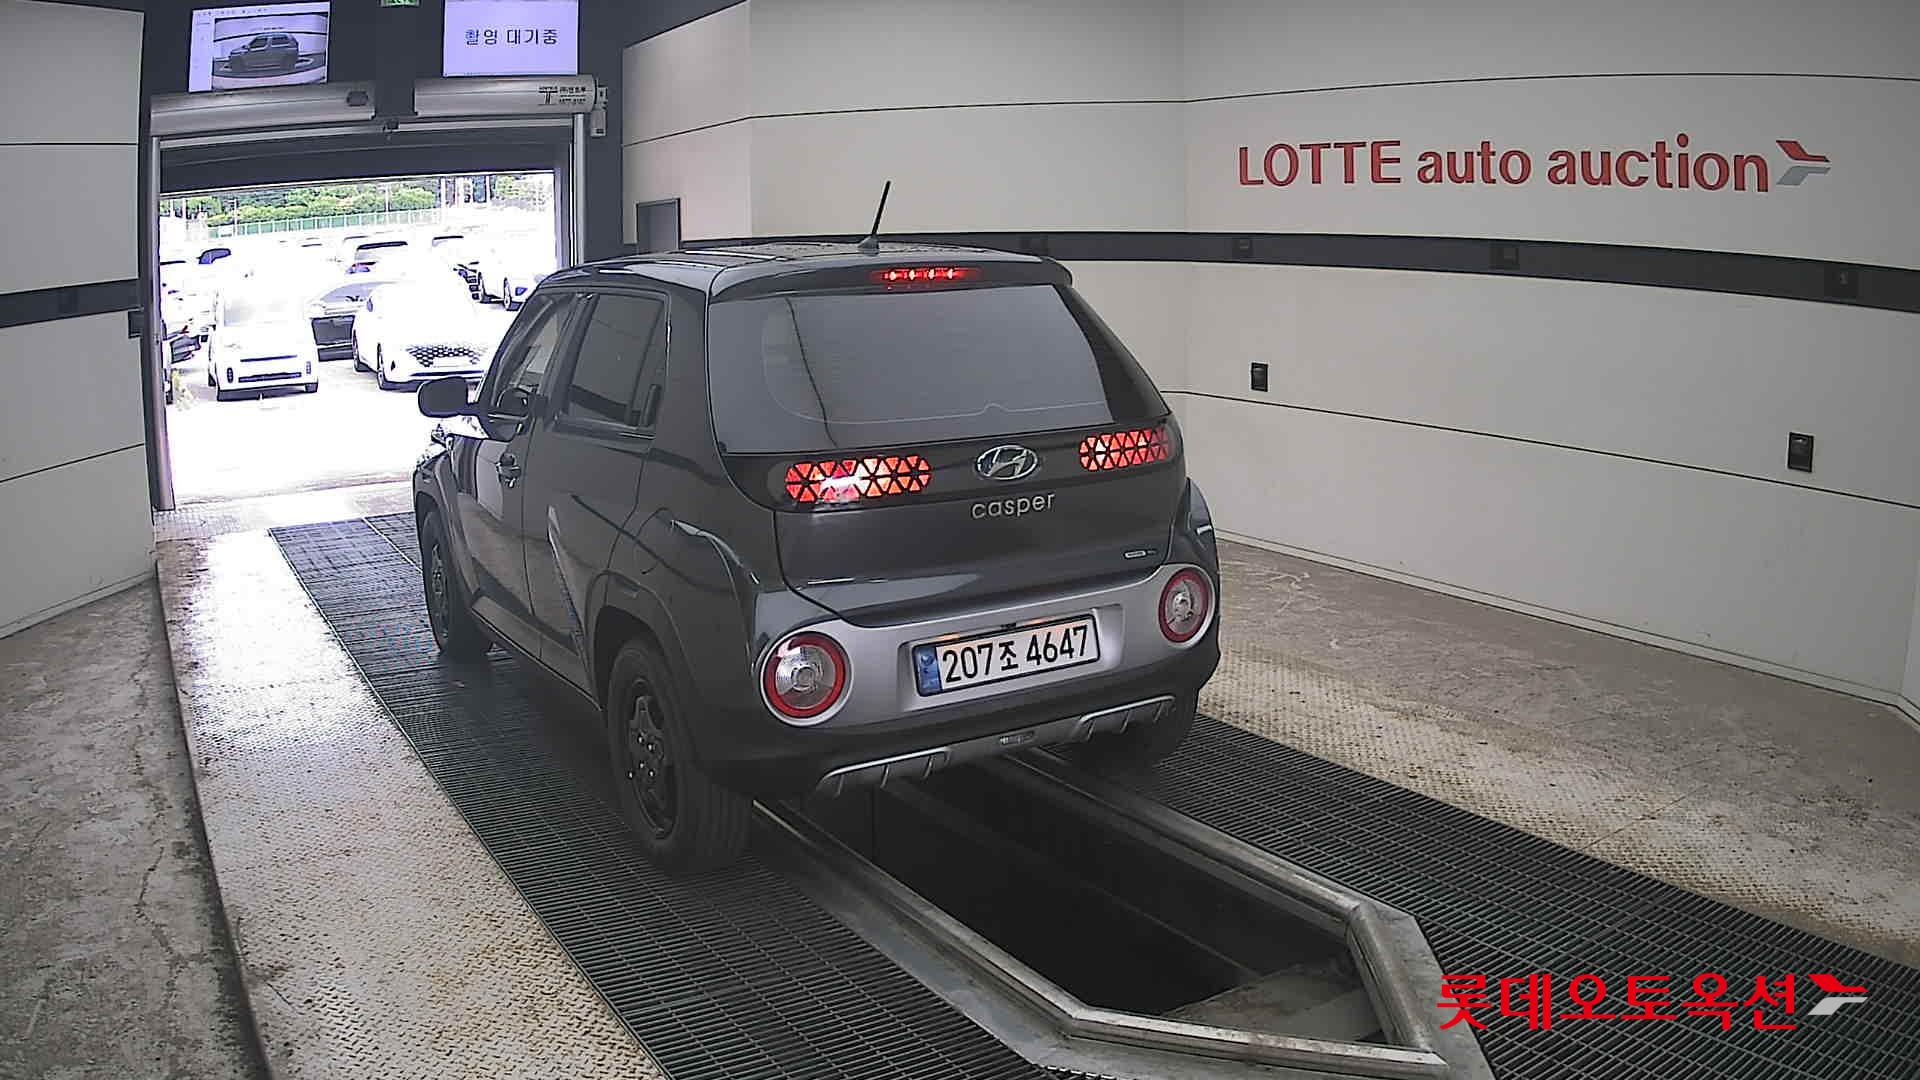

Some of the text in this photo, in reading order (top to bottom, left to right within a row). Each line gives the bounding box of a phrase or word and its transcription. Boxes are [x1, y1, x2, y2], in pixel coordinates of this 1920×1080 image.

[506, 28, 558, 45] 대기중
[1239, 133, 1769, 193] LOTTE auto auction
[972, 493, 1055, 519] casper
[942, 624, 1089, 683] 207조 4647
